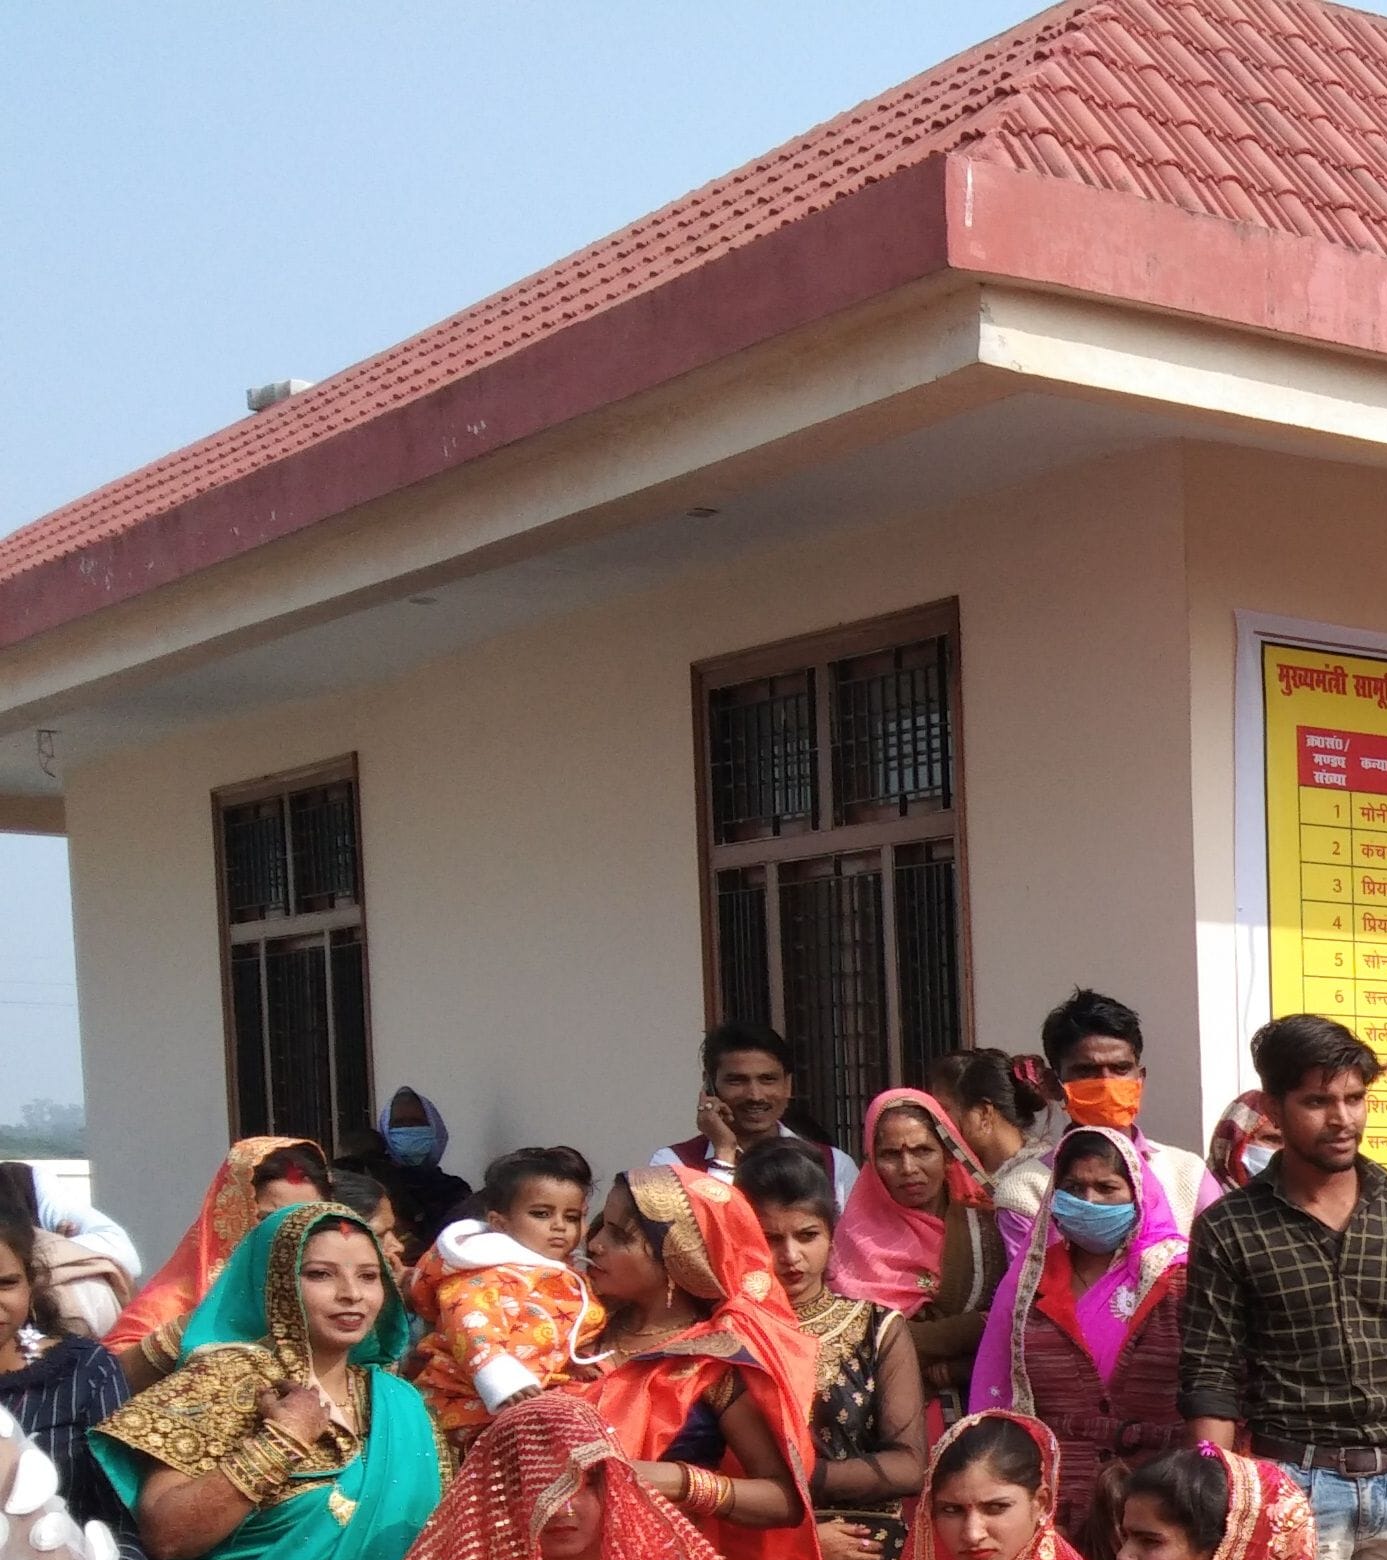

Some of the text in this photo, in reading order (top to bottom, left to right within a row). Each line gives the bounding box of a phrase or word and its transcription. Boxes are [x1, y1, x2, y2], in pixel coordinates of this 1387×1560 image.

[1277, 663, 1348, 696] मुख्यमंत्री
[1333, 804, 1340, 819] 1
[1332, 841, 1341, 856] 2
[1333, 878, 1342, 893] 3
[1332, 915, 1342, 930] 4
[1334, 953, 1343, 967] 5
[1335, 990, 1344, 1003] 6
